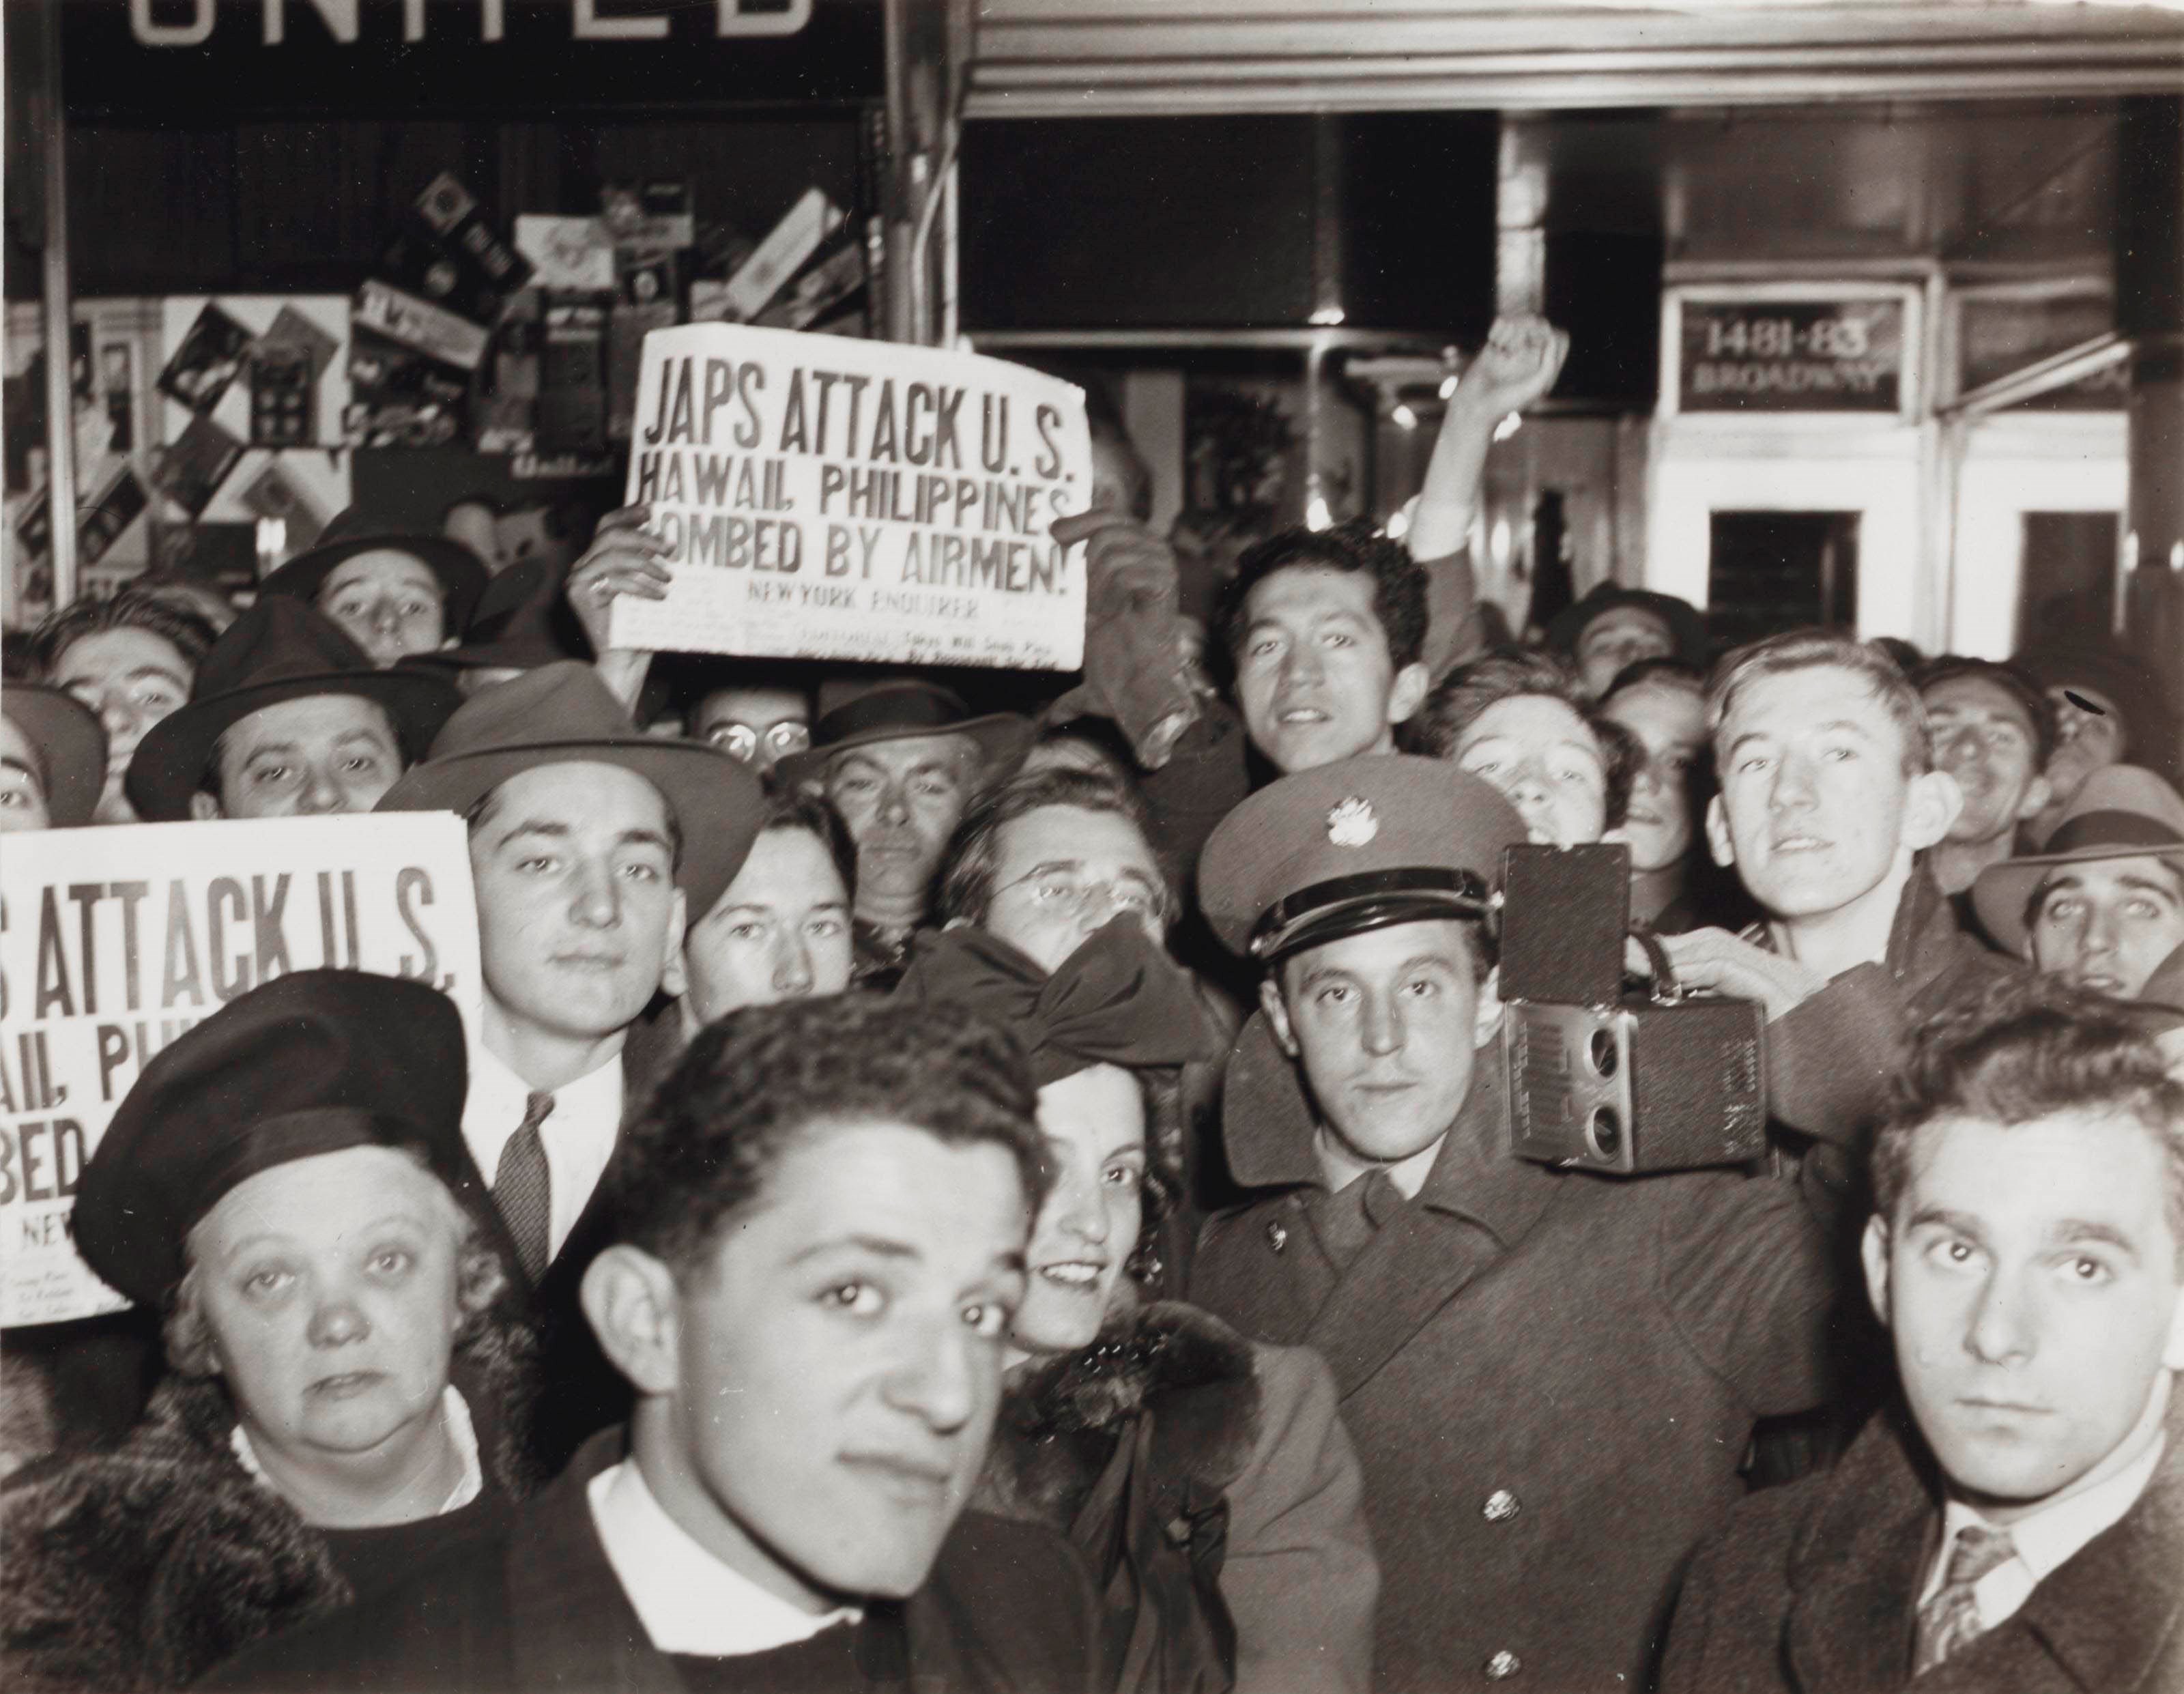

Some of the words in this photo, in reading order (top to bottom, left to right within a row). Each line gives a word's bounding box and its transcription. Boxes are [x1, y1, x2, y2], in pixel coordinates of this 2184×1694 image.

[644, 356, 767, 448] JAPS
[780, 367, 969, 471] ATTACK
[981, 392, 1020, 476] U.
[1035, 404, 1074, 482] S.
[635, 450, 794, 511] HAWAII,
[659, 512, 803, 574] OMBED
[824, 524, 885, 579] BY
[900, 536, 1067, 597] AIRMEN!
[748, 579, 796, 602] NEW
[799, 583, 856, 609] YORK
[35, 871, 293, 1020] ATTACK
